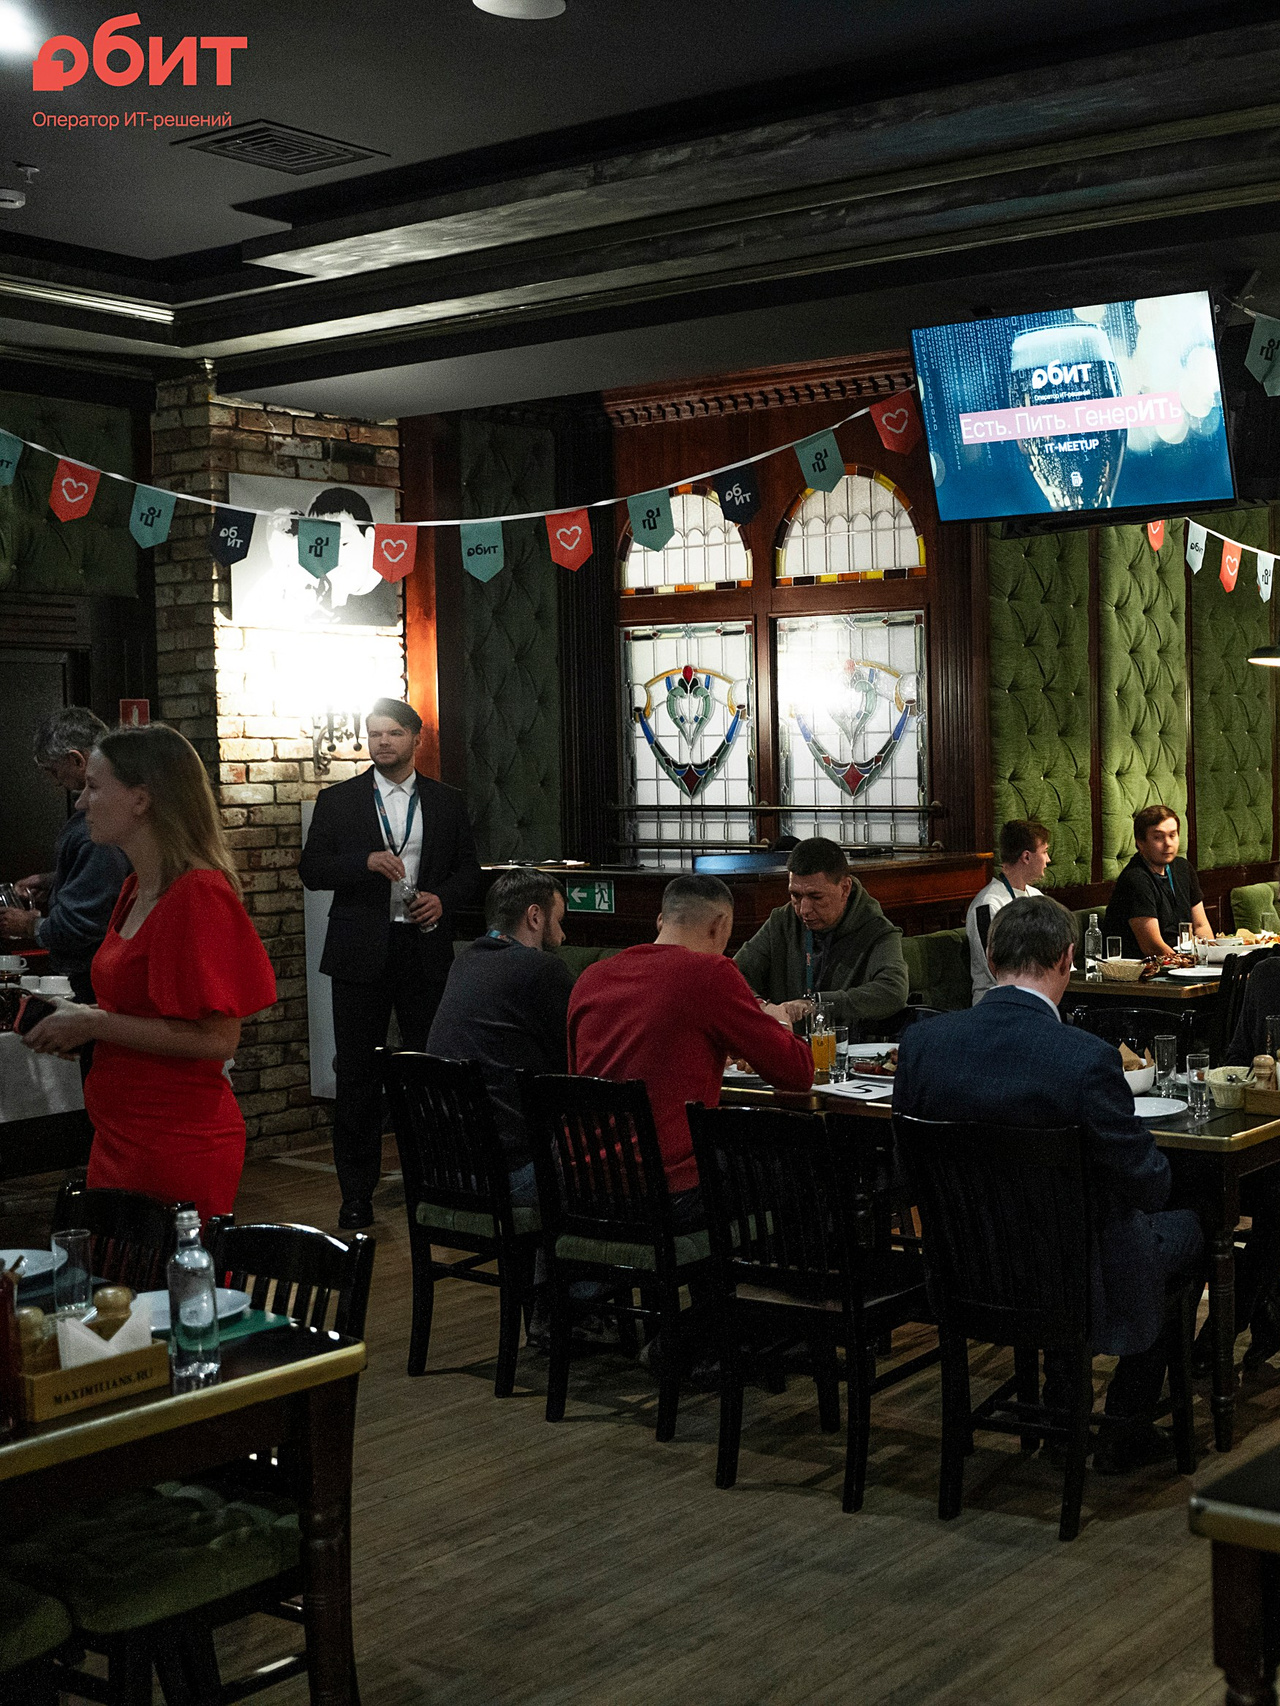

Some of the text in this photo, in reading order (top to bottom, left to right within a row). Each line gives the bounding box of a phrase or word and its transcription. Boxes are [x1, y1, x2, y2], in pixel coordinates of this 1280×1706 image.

[1031, 359, 1092, 389] обит
[961, 397, 1183, 440] Есть. Пить. ГенерИТь
[1044, 439, 1100, 454] IT-MEETUP
[467, 543, 499, 557] обит
